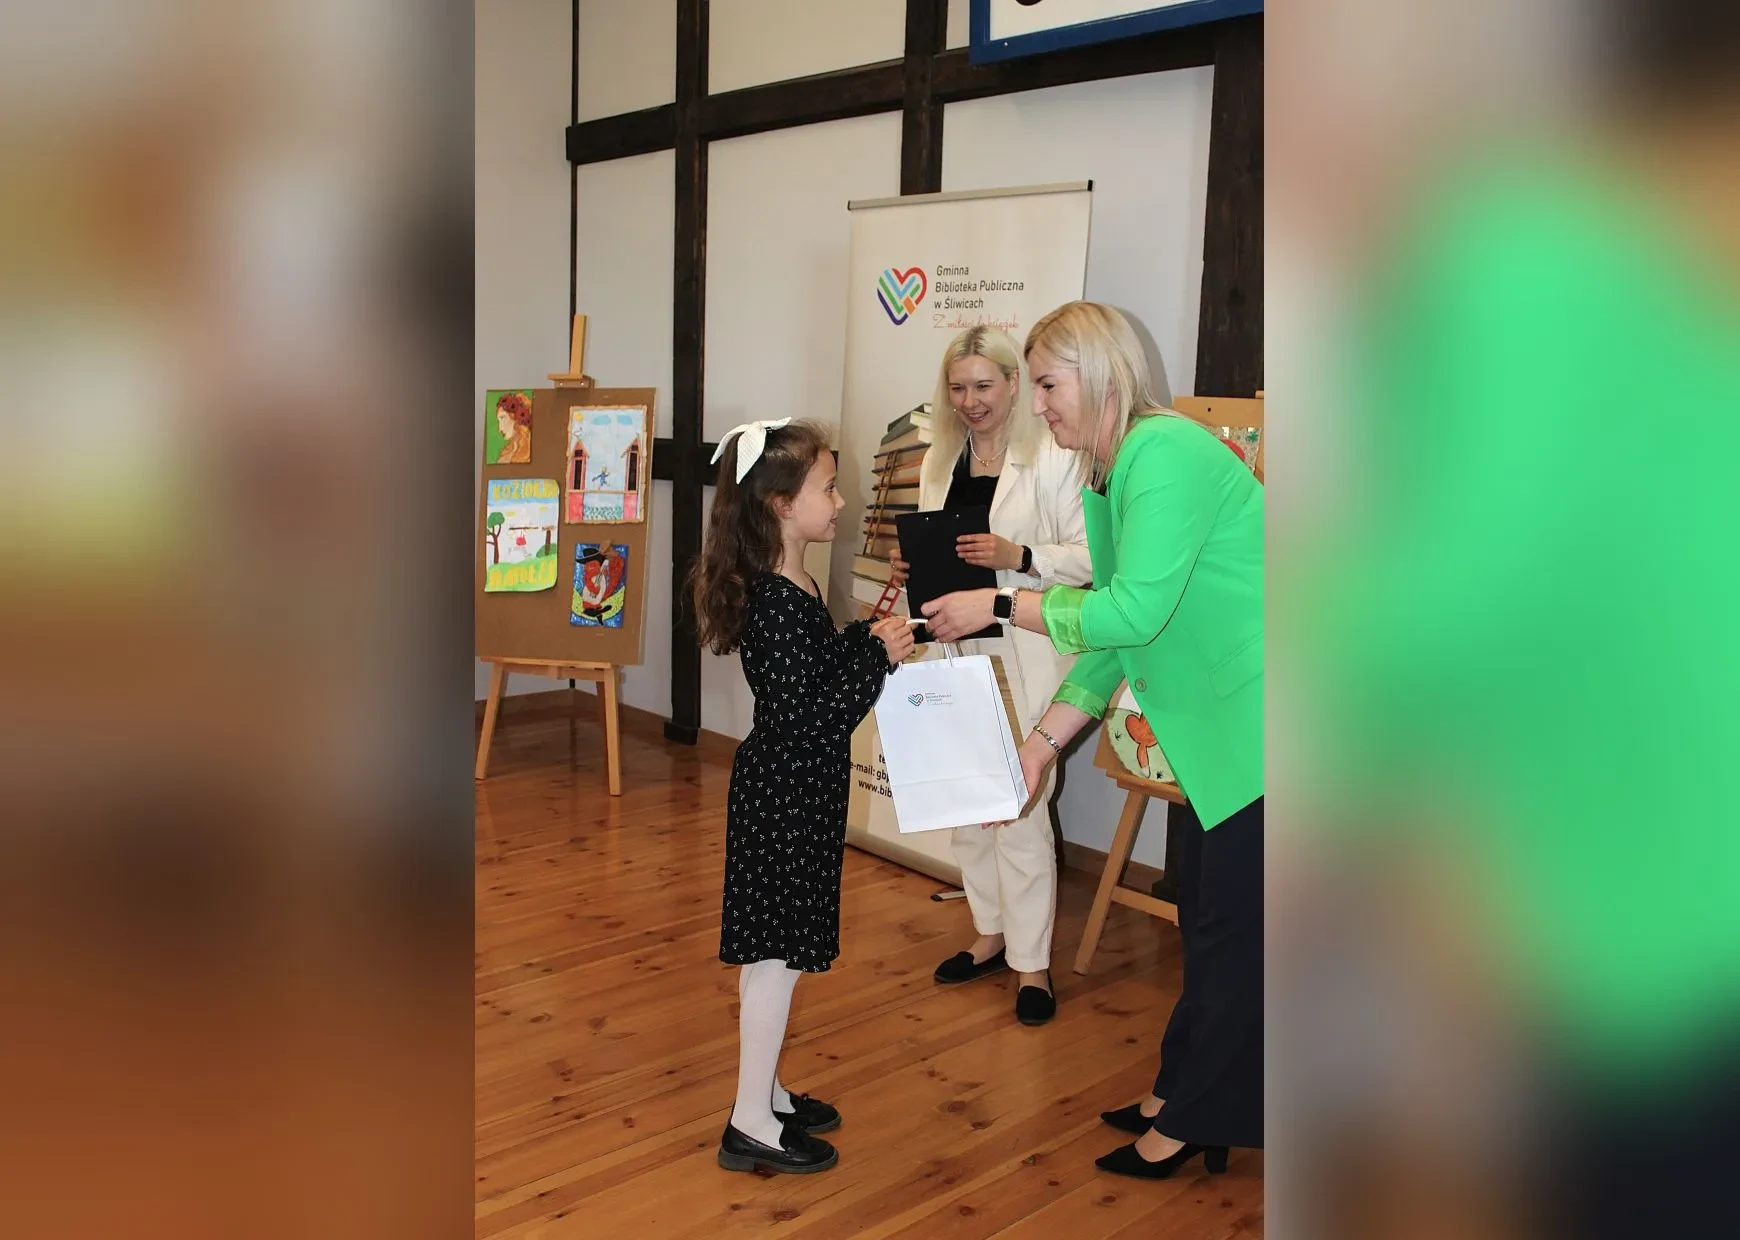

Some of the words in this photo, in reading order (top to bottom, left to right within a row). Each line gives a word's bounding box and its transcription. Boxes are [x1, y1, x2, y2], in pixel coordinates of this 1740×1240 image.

[936, 264, 969, 276] Gminna
[935, 281, 977, 292] Biblioteka
[979, 280, 1024, 291] Publiczna
[934, 301, 941, 309] w
[944, 296, 983, 309] Śliwicach
[850, 761, 876, 776] e-mail:
[858, 780, 893, 799] www.bib
